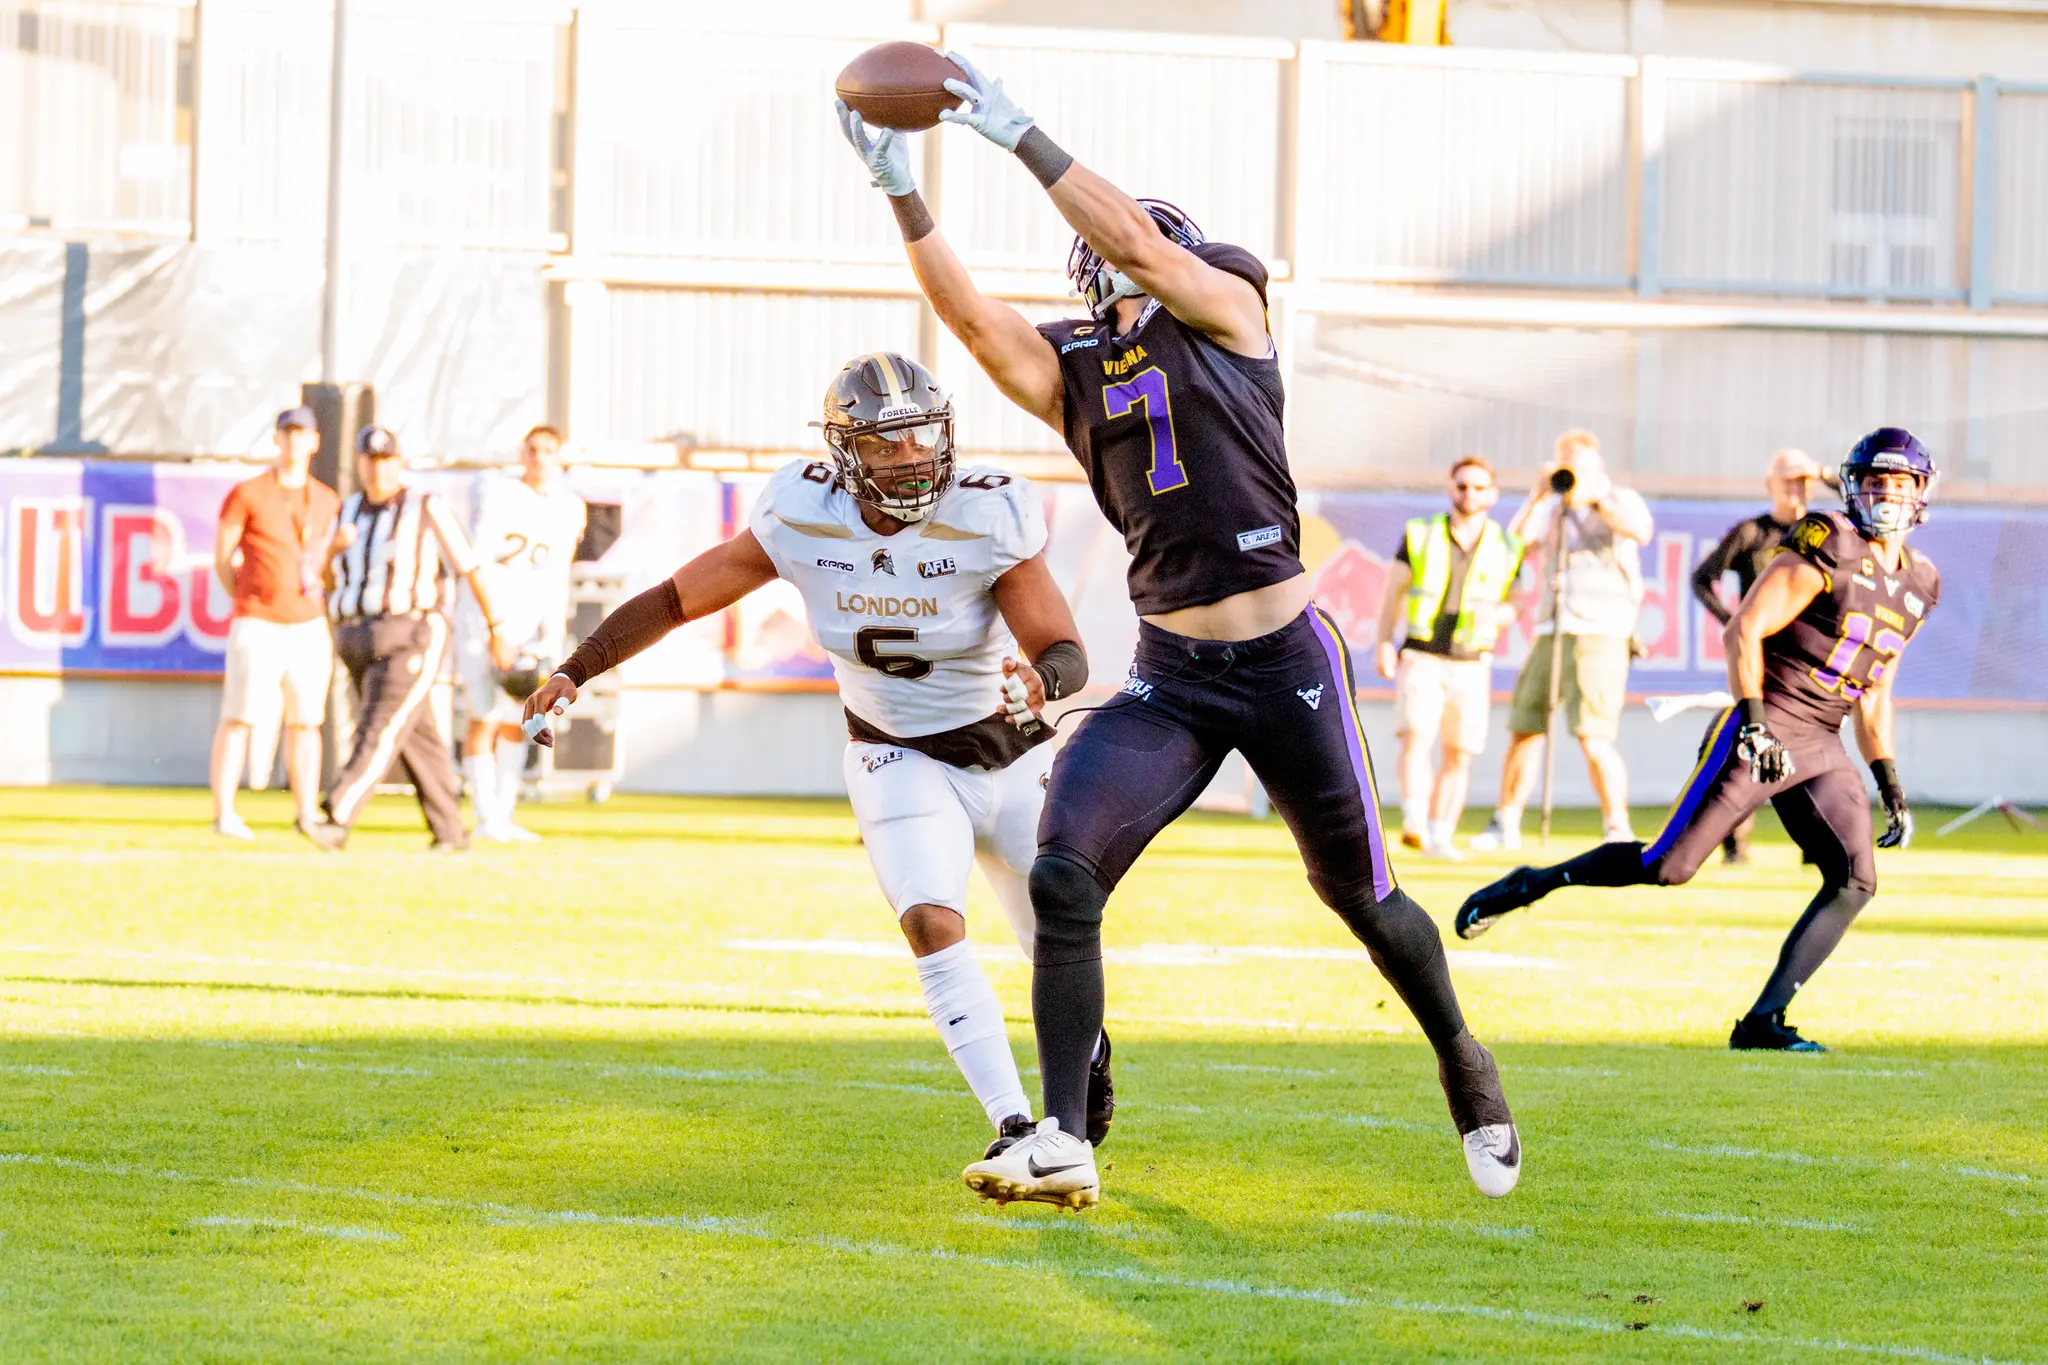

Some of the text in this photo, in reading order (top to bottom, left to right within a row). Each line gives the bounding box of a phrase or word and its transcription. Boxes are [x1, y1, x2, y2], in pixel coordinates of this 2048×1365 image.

[881, 407, 919, 419] FORELLE
[1103, 365, 1189, 496] 7
[922, 557, 956, 577] AFLE
[836, 591, 939, 618] LONDON
[853, 625, 934, 681] 6
